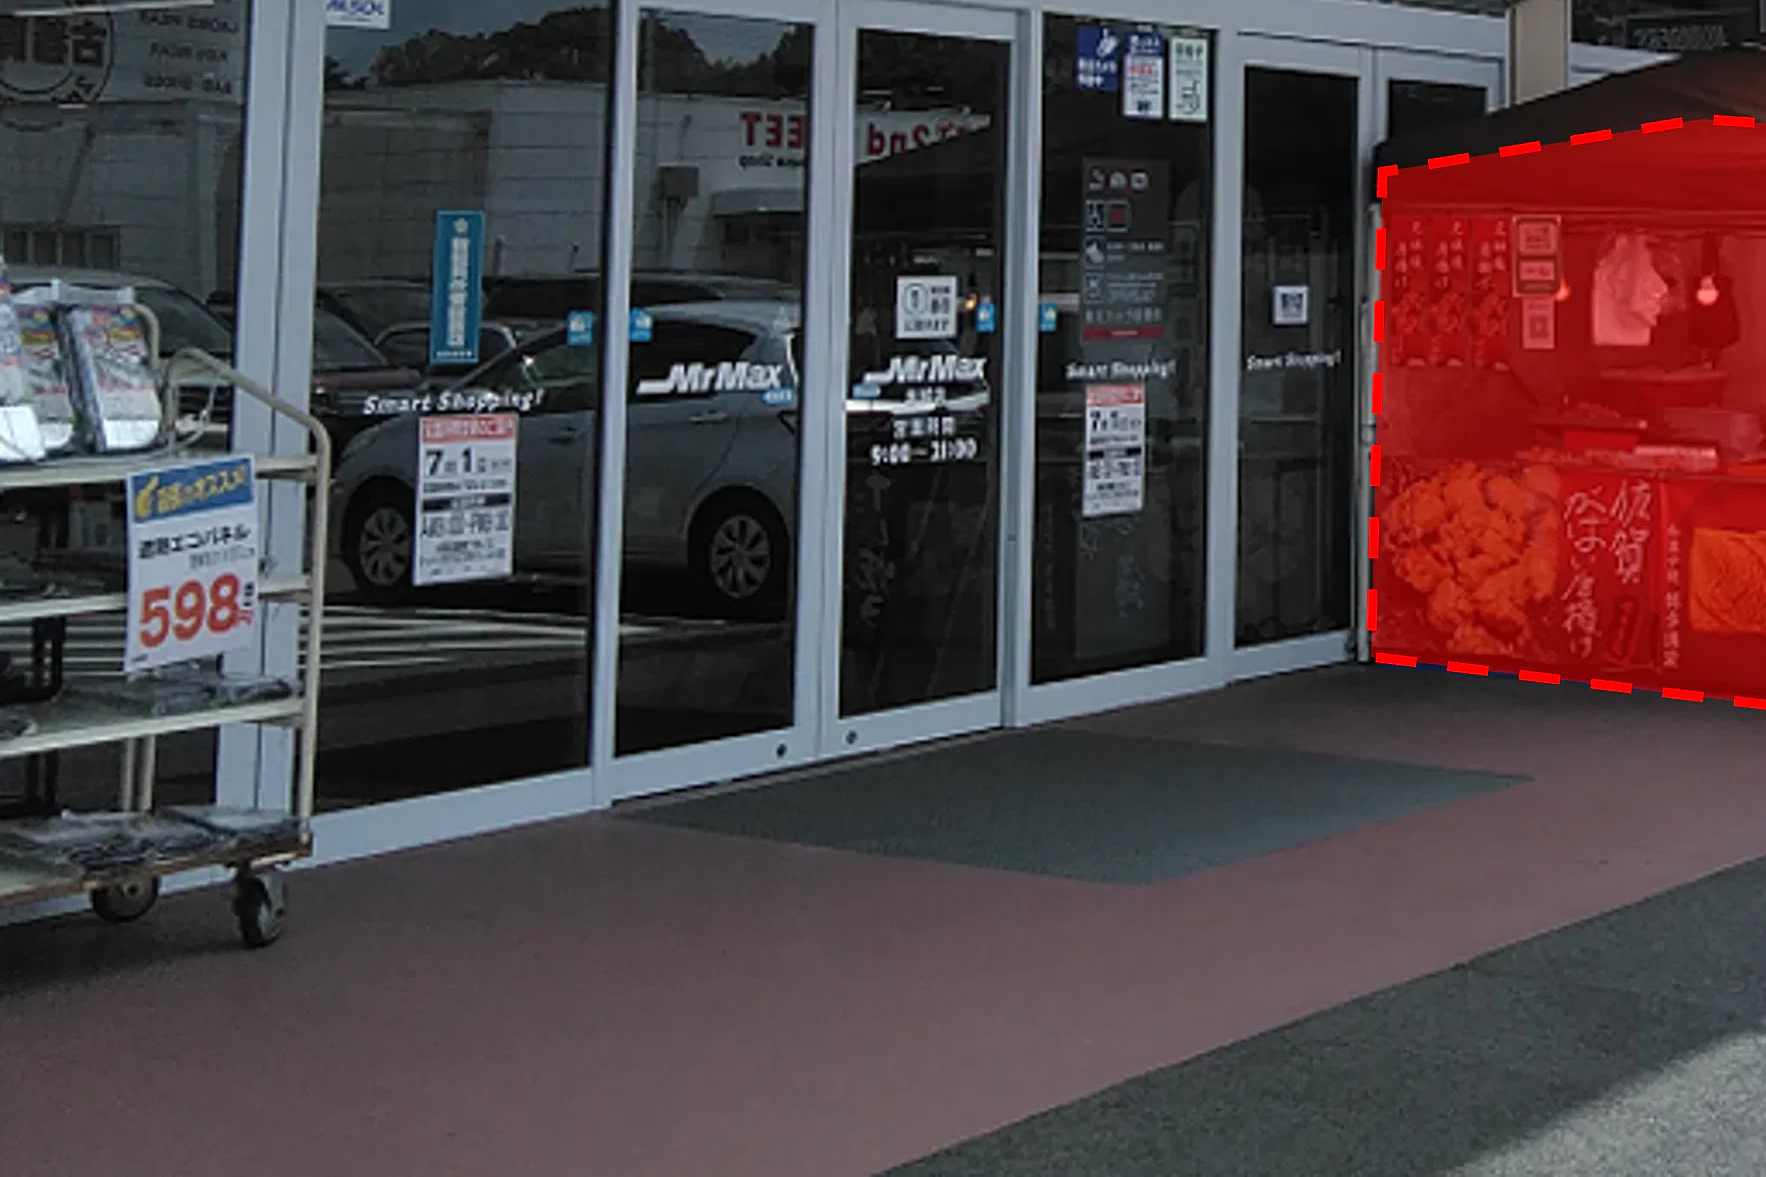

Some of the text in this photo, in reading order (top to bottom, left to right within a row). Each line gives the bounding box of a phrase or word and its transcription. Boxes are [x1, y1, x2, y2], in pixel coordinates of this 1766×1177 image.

[636, 362, 783, 395] MrMax
[362, 389, 546, 414] Smart Shopping!
[139, 573, 240, 648] 598
